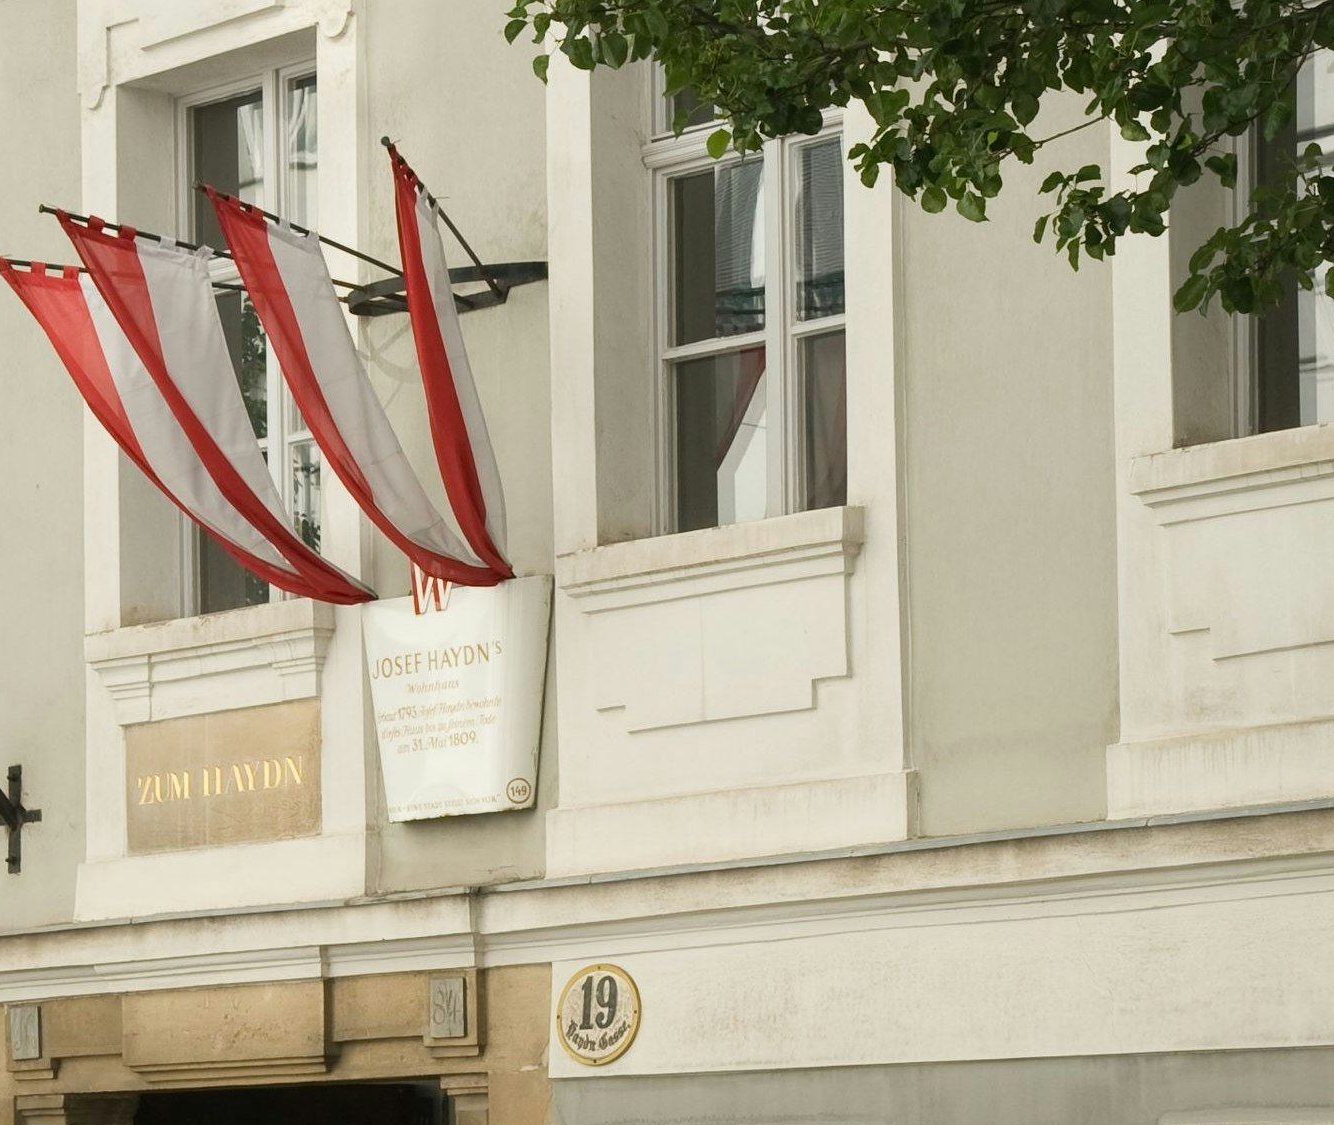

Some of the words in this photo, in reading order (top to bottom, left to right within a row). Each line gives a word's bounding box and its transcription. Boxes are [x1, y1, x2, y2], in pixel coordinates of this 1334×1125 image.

[373, 653, 421, 679] JOSEF
[427, 641, 503, 671] HAYDN'S
[408, 680, 459, 695] Wohnhaus
[138, 772, 191, 806] ZUM
[203, 755, 304, 798] HAYDN
[510, 785, 527, 797] 149
[579, 975, 618, 1030] 19
